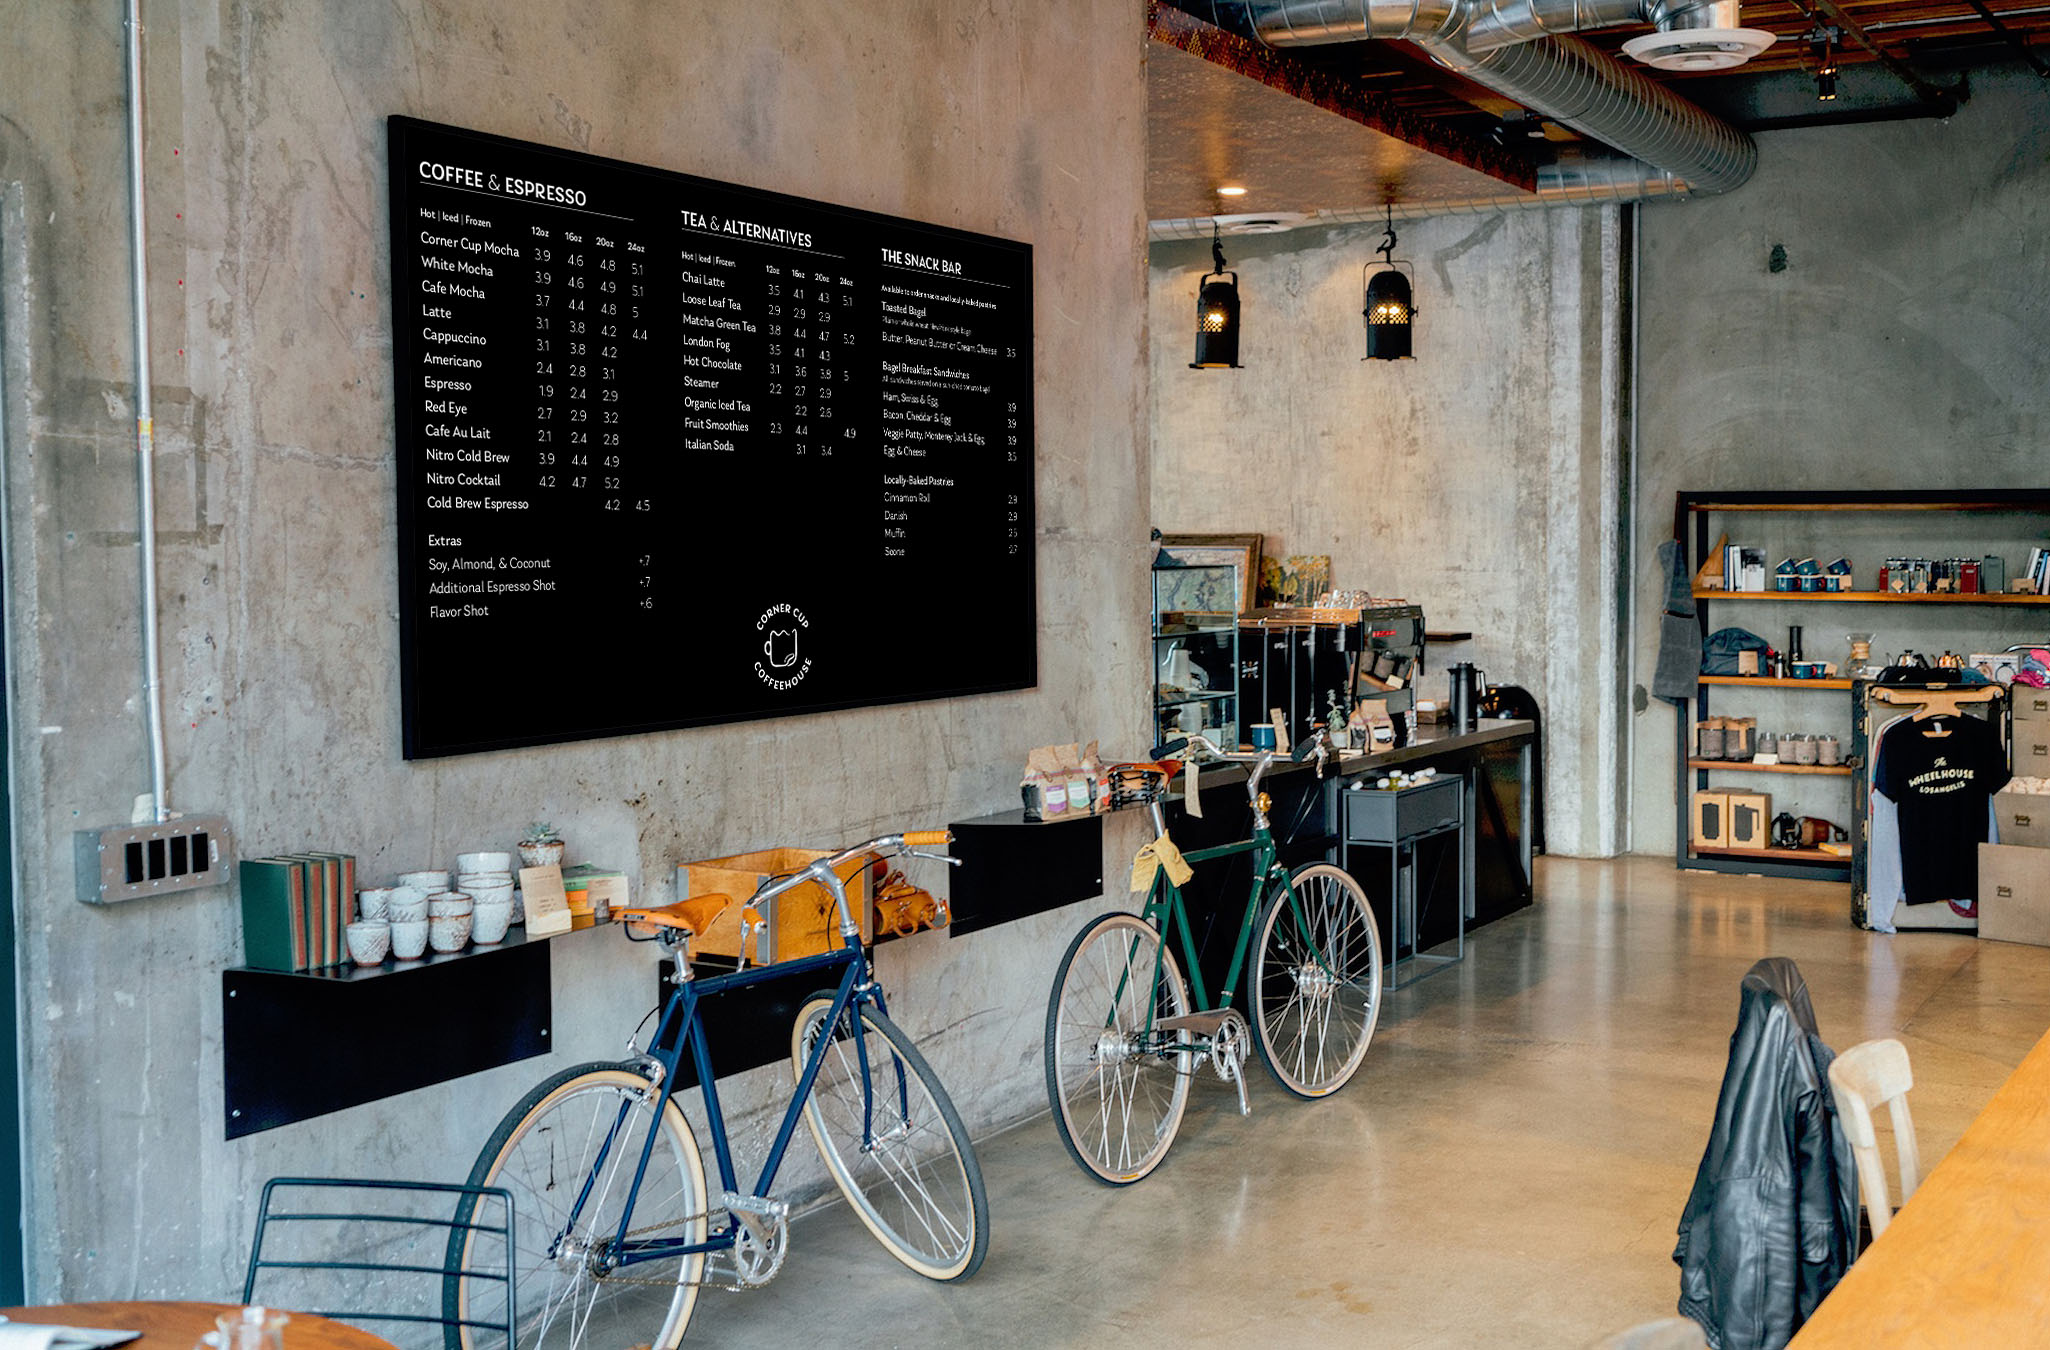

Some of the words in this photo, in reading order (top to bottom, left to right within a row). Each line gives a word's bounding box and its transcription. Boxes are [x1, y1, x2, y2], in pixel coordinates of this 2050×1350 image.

[419, 161, 483, 188] COFFEE
[488, 174, 500, 191] &
[506, 177, 586, 206] ESPRESSO
[420, 208, 436, 219] Hot
[442, 211, 459, 223] Iced
[465, 215, 491, 228] Frozen
[531, 226, 549, 237] 12oz
[565, 232, 582, 243] 16oz
[596, 237, 614, 248] 20oz
[628, 242, 645, 253] 24oz
[681, 210, 707, 229] TEA
[710, 216, 720, 231] &
[723, 219, 812, 248] ALTERNATIVES
[421, 231, 458, 248] Corner
[460, 237, 482, 254] Cup
[484, 241, 520, 257] Mocha
[535, 248, 551, 262] 3.9
[567, 254, 583, 267] 4.6
[600, 259, 616, 272] 4.8
[632, 263, 642, 275] 5.1
[881, 248, 902, 264] THE
[904, 253, 939, 271] SNACK
[942, 259, 961, 275] BAR
[421, 255, 455, 272] White
[458, 261, 493, 277] Mocha
[535, 271, 551, 284] 3.9
[568, 276, 584, 289] 4.6
[600, 281, 616, 293] 4.9
[632, 285, 643, 296] 5.1
[682, 271, 702, 284] Chai
[703, 275, 725, 288] Latte
[422, 280, 446, 294] Cafe
[449, 284, 485, 299] Mocha
[536, 294, 550, 306] 3.7
[568, 299, 584, 311] 4.4
[601, 303, 616, 315] 4.8
[683, 292, 707, 306] Loose
[708, 296, 726, 308] Leaf
[727, 298, 741, 311] Tea
[423, 304, 451, 319] Latte
[537, 317, 548, 329] 3.1
[570, 321, 585, 334] 3.8
[601, 325, 616, 337] 4.2
[633, 329, 647, 340] 4.4
[683, 314, 714, 327] Matcha
[716, 317, 741, 331] Green
[742, 321, 756, 333] Tea
[423, 327, 487, 345] Cappuccino
[537, 338, 549, 351] 3.1
[570, 342, 586, 355] 3.8
[602, 347, 617, 358] 4.2
[684, 334, 714, 348] London
[716, 338, 731, 353] Fog
[424, 352, 482, 368] Americano
[536, 362, 553, 374] 2.4
[570, 364, 586, 377] 2.8
[603, 367, 614, 379] 3.1
[684, 354, 699, 366] Hot
[701, 356, 742, 371] Chocolate
[424, 376, 472, 392] Espresso
[539, 385, 554, 397] 1.9
[570, 387, 586, 399] 2.4
[603, 390, 618, 402] 2.9
[684, 376, 719, 388] Steamer
[425, 400, 446, 413] Red
[449, 401, 467, 417] Eye
[538, 407, 552, 419] 2.7
[570, 410, 587, 422] 2.9
[604, 412, 618, 423] 3.2
[684, 396, 717, 411] Organic
[718, 399, 735, 410] Iced
[736, 400, 751, 412] Tea
[685, 417, 704, 429] Fruit
[706, 418, 749, 431] Smoothies
[425, 424, 450, 437] Cafe
[452, 426, 468, 438] Au
[470, 426, 491, 439] Lait
[538, 429, 551, 442] 2.1
[571, 432, 587, 443] 2.4
[604, 434, 619, 445] 2.8
[685, 438, 712, 450] Italian
[713, 440, 734, 451] Soda
[426, 448, 454, 461] Nitro
[457, 449, 481, 462] Cold
[484, 450, 510, 463] Brew
[539, 452, 555, 465] 3.9
[571, 454, 587, 466] 4.4
[604, 455, 619, 467] 4.9
[427, 472, 455, 485] Nitro
[457, 473, 501, 486] Cocktail
[539, 475, 555, 487] 4.2
[572, 477, 586, 487] 4.7
[605, 477, 619, 489] 5.2
[427, 496, 452, 508] Cold
[455, 497, 482, 509] Brew
[485, 497, 529, 512] Espresso
[605, 499, 620, 510] 4.2
[636, 499, 650, 511] 4.5
[429, 534, 462, 546] Extras
[499, 557, 507, 569] &
[509, 557, 551, 569] Coconut
[429, 581, 484, 594] Additional
[487, 581, 530, 595] Espresso
[533, 579, 555, 591] Shot
[430, 606, 462, 618] Flavor
[463, 604, 489, 616] Shot
[756, 603, 791, 631] CORNER
[793, 608, 809, 628] CUP
[754, 657, 812, 691] COFFEEHOUSE
[1908, 768, 1975, 788] WHEELHOUSE
